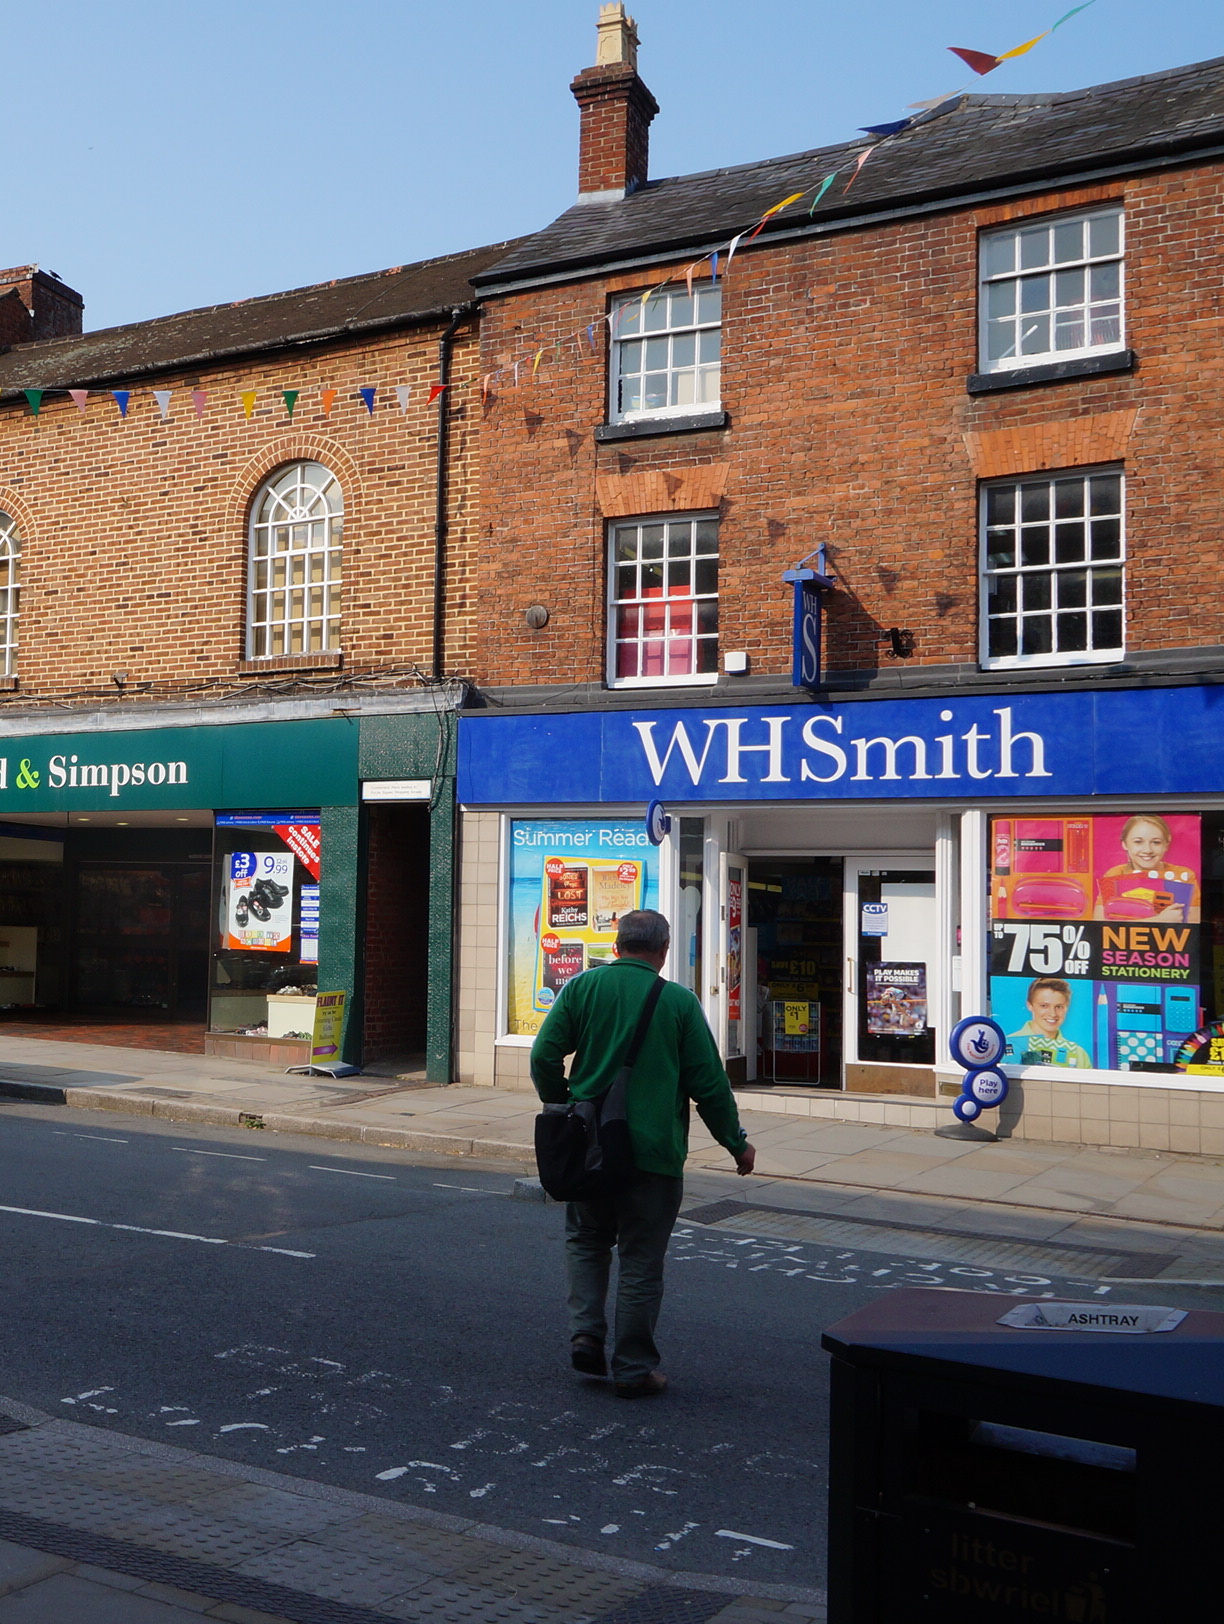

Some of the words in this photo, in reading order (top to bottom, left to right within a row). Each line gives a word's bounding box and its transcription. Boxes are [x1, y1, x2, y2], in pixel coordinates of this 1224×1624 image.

[632, 706, 1053, 787] WHSmith
[15, 757, 40, 790] &
[47, 753, 189, 798] Simpson
[288, 826, 320, 863] continues
[301, 826, 320, 849] SALE
[513, 829, 592, 846] Summer
[599, 829, 653, 846] Read
[235, 853, 250, 868] £3
[264, 856, 288, 874] 9.99
[235, 869, 248, 878] off
[557, 889, 583, 899] LOST
[561, 906, 578, 914] Kathy
[863, 904, 887, 913] CCTV
[552, 913, 587, 923] REICHS
[994, 931, 1004, 939] TO
[1102, 925, 1191, 952] NEW
[1003, 923, 1091, 974] 75%
[548, 954, 582, 964] before
[1102, 951, 1190, 967] SEASON
[1064, 960, 1090, 975] OFF
[1101, 966, 1191, 979] STATIONERY
[317, 995, 337, 1008] FLAUNT
[338, 994, 345, 1006] IT
[514, 1019, 538, 1031] The
[979, 1079, 998, 1088] Play
[1068, 1313, 1139, 1327] ASHTRAY
[952, 1532, 1034, 1575] litter
[930, 1567, 1059, 1616] sbwriel
